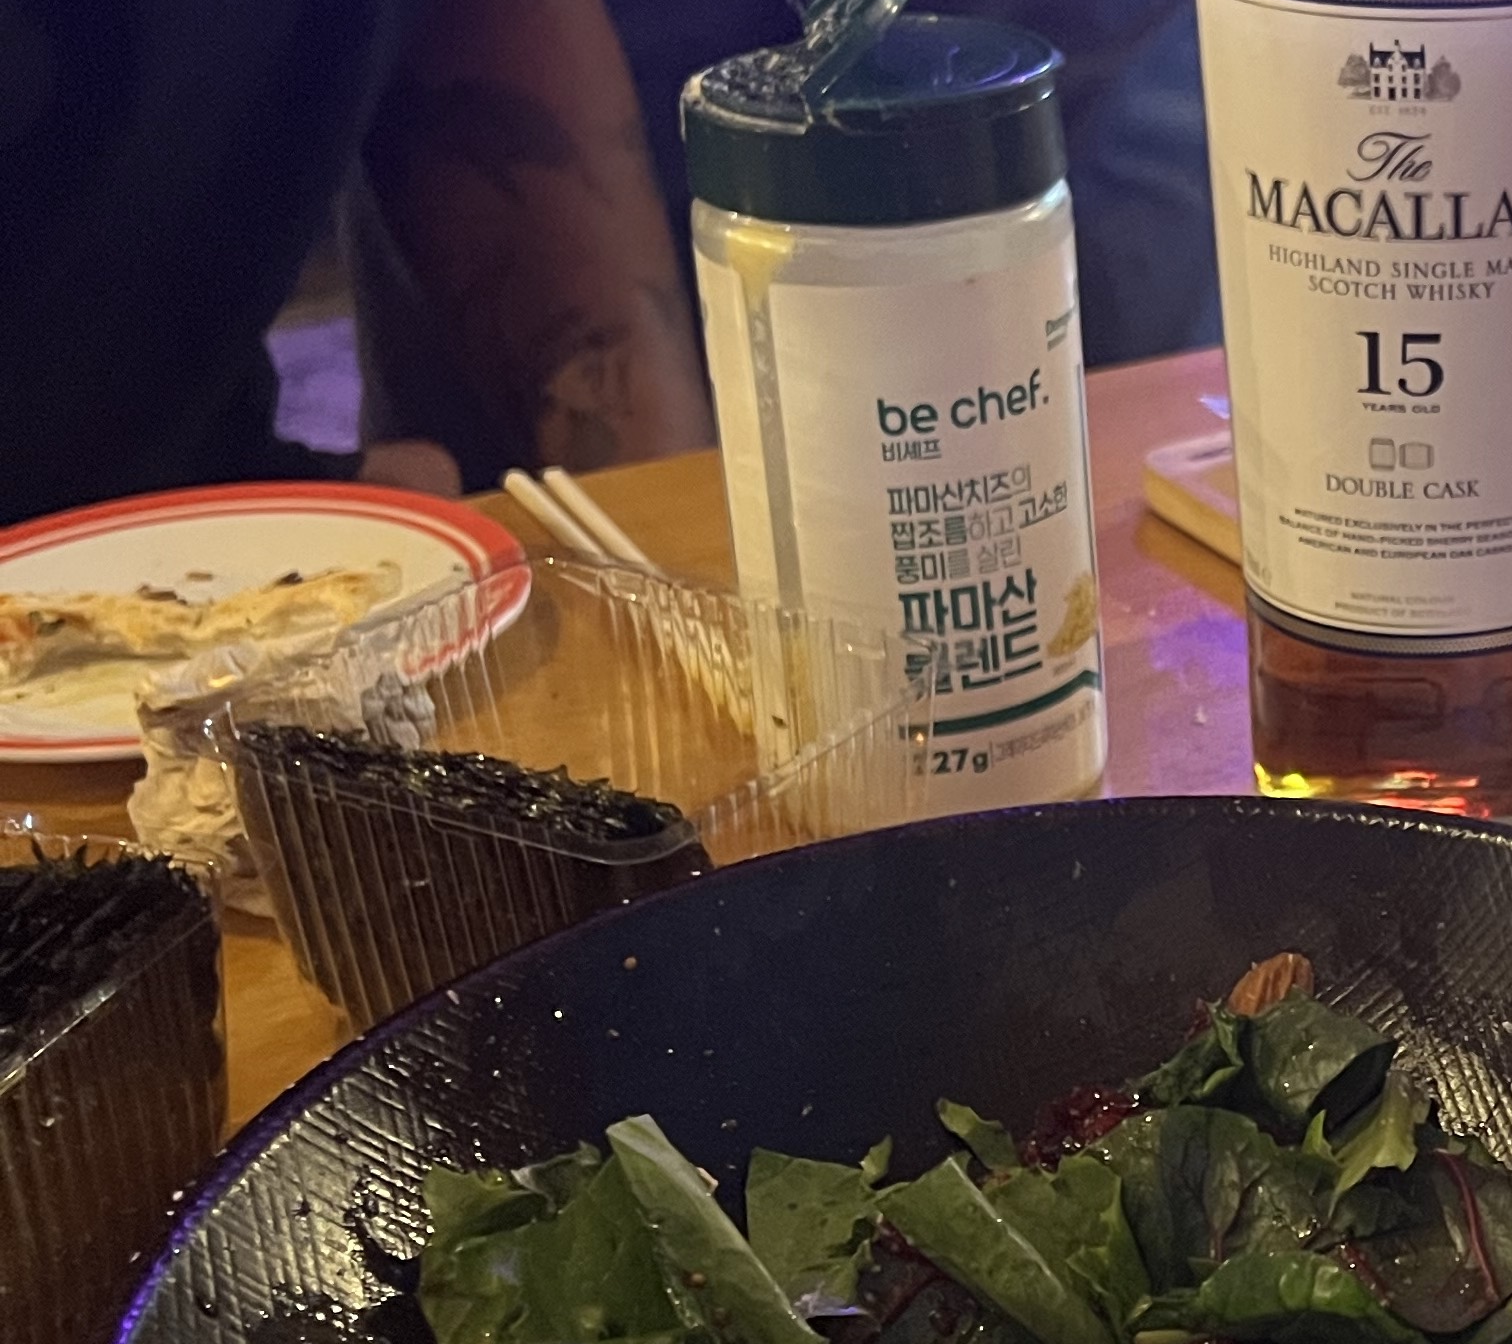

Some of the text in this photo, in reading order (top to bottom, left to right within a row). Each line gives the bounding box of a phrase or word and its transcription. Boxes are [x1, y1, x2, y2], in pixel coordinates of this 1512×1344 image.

[1347, 132, 1433, 181] The
[1268, 244, 1381, 278] HIGHLAND
[1391, 260, 1474, 280] SINGLE
[1308, 275, 1496, 302] SCOTCH WHISKY
[1355, 331, 1444, 397] 15
[876, 367, 1050, 437] be chef.
[881, 439, 942, 462] 비세프
[1325, 473, 1480, 500] DOUBLE CASK
[898, 568, 1038, 636] 파마산
